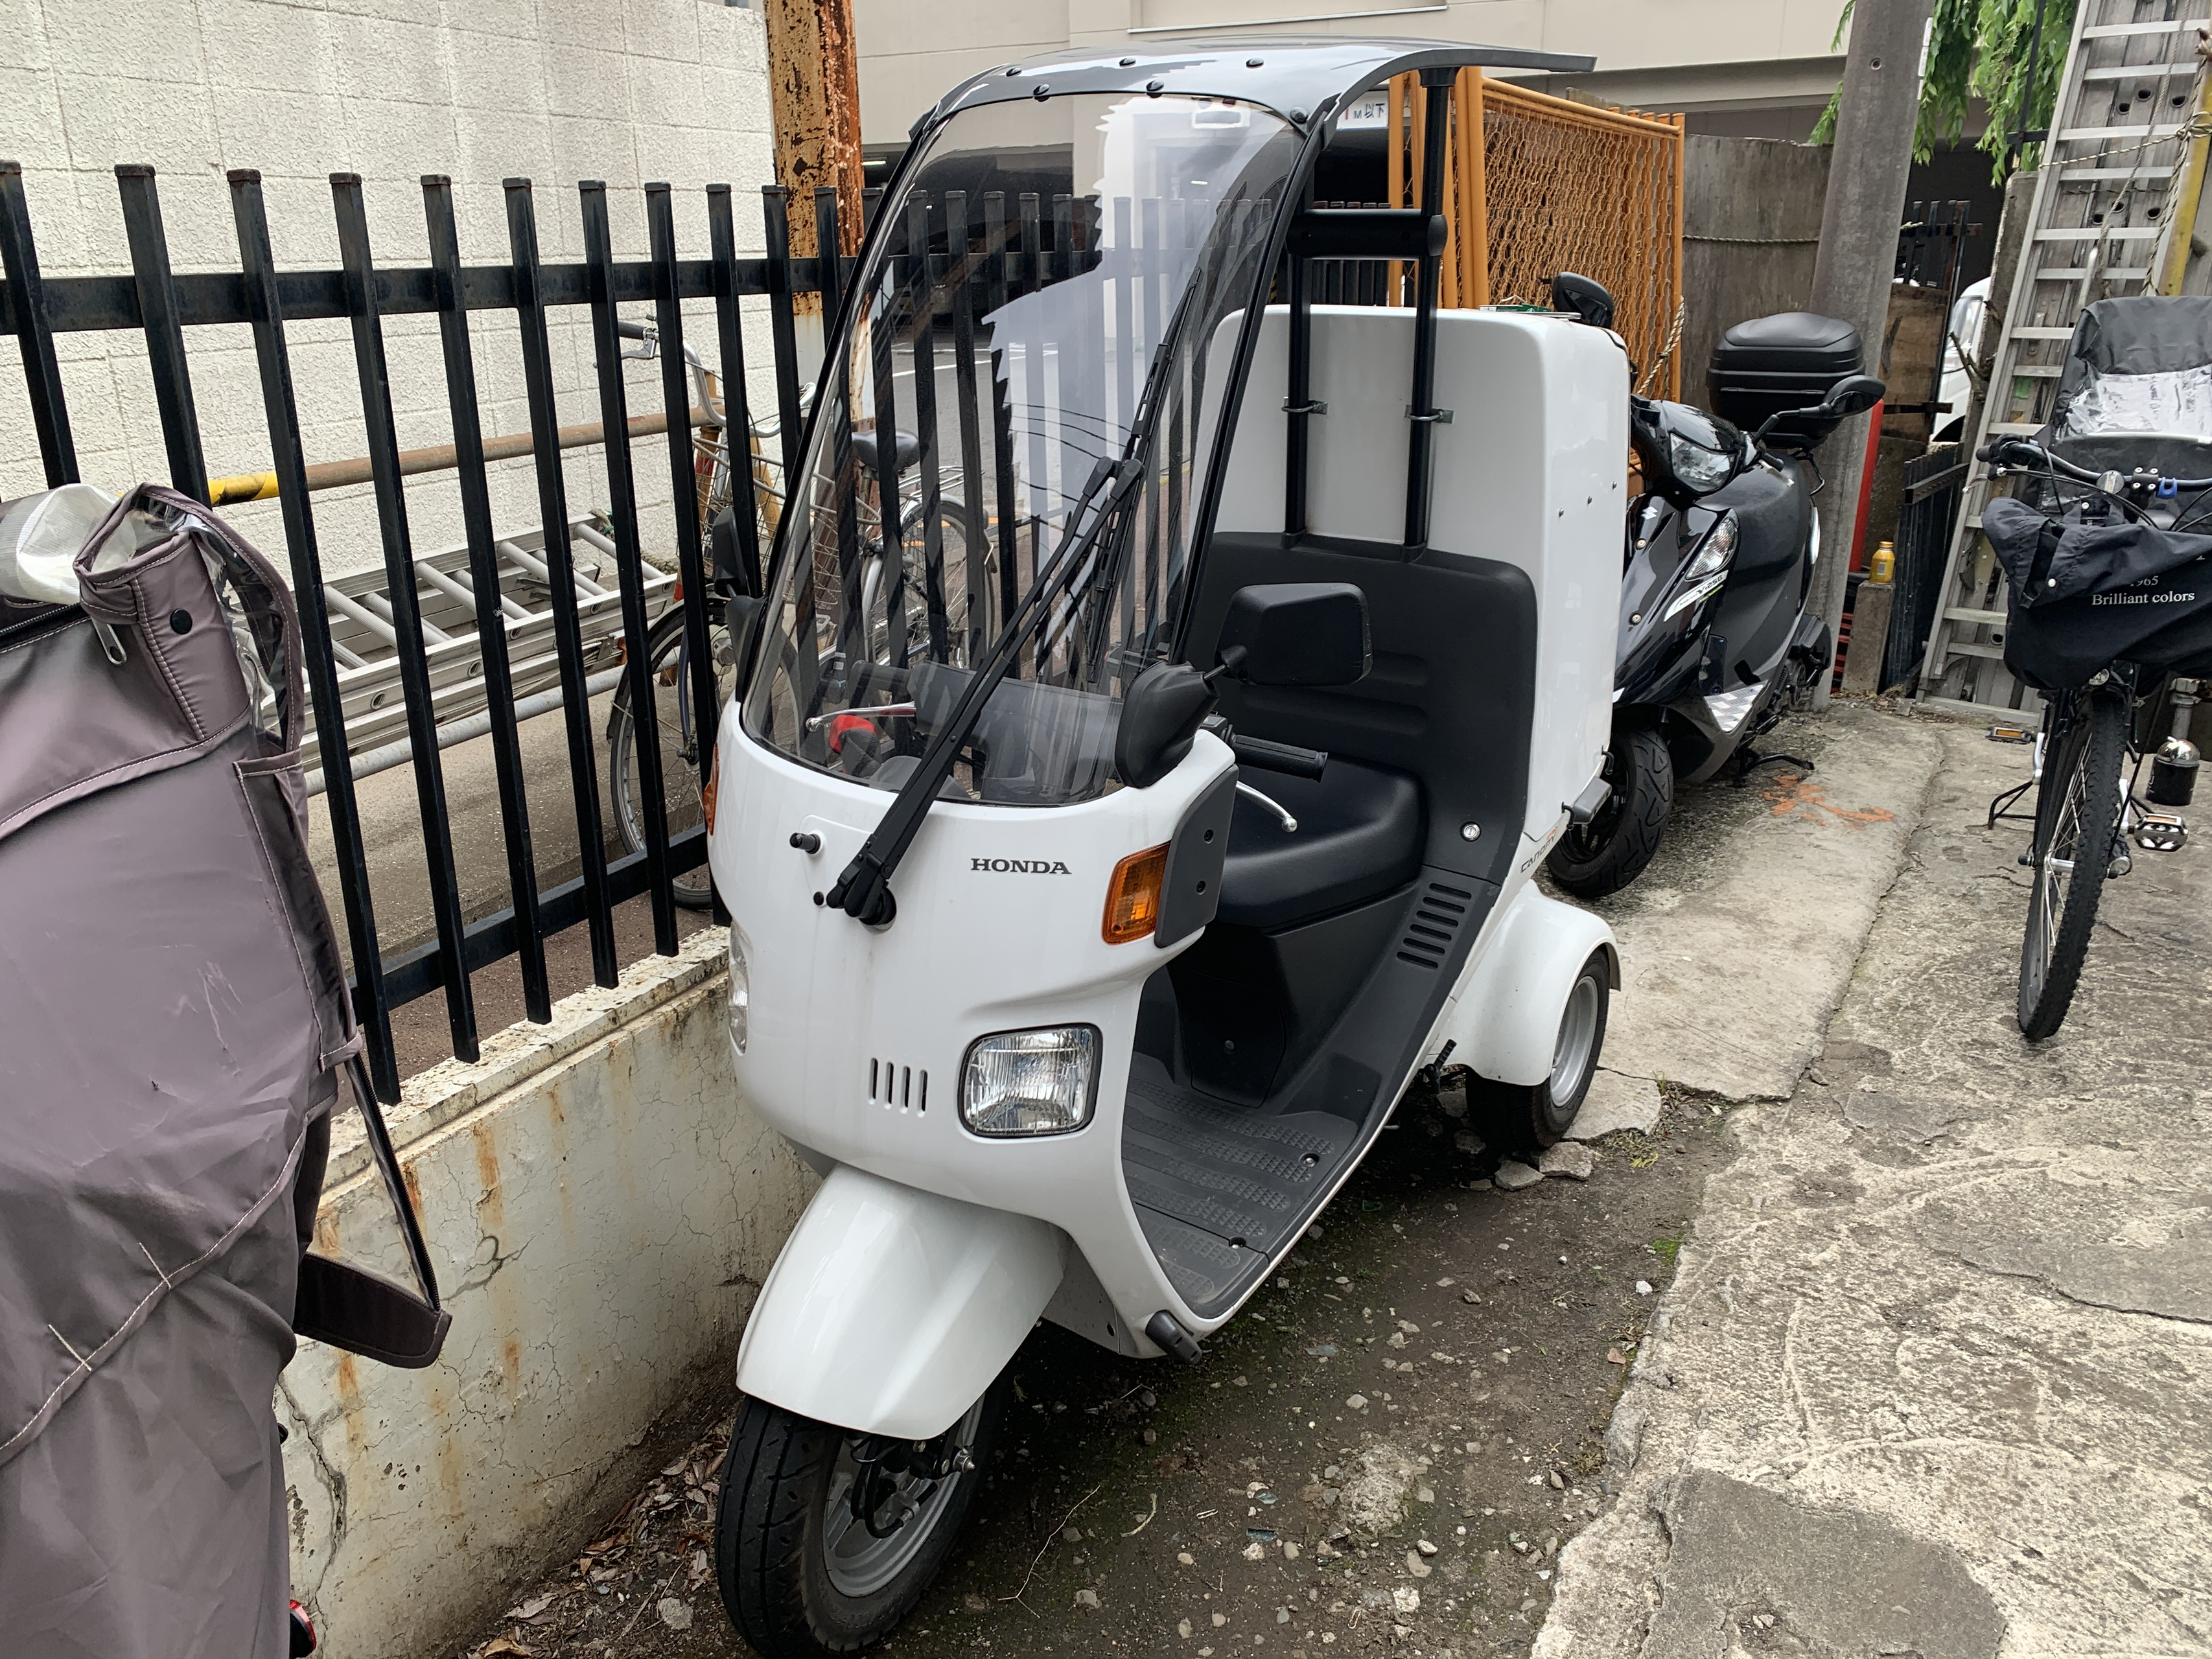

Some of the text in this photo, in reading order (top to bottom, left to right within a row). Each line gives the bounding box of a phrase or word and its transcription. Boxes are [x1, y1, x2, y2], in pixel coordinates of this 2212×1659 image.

[1695, 575, 1723, 594] V125G
[2091, 590, 2195, 606] Brilliant colors
[1520, 831, 1557, 874] CANOPY
[971, 858, 1072, 875] HONDA
